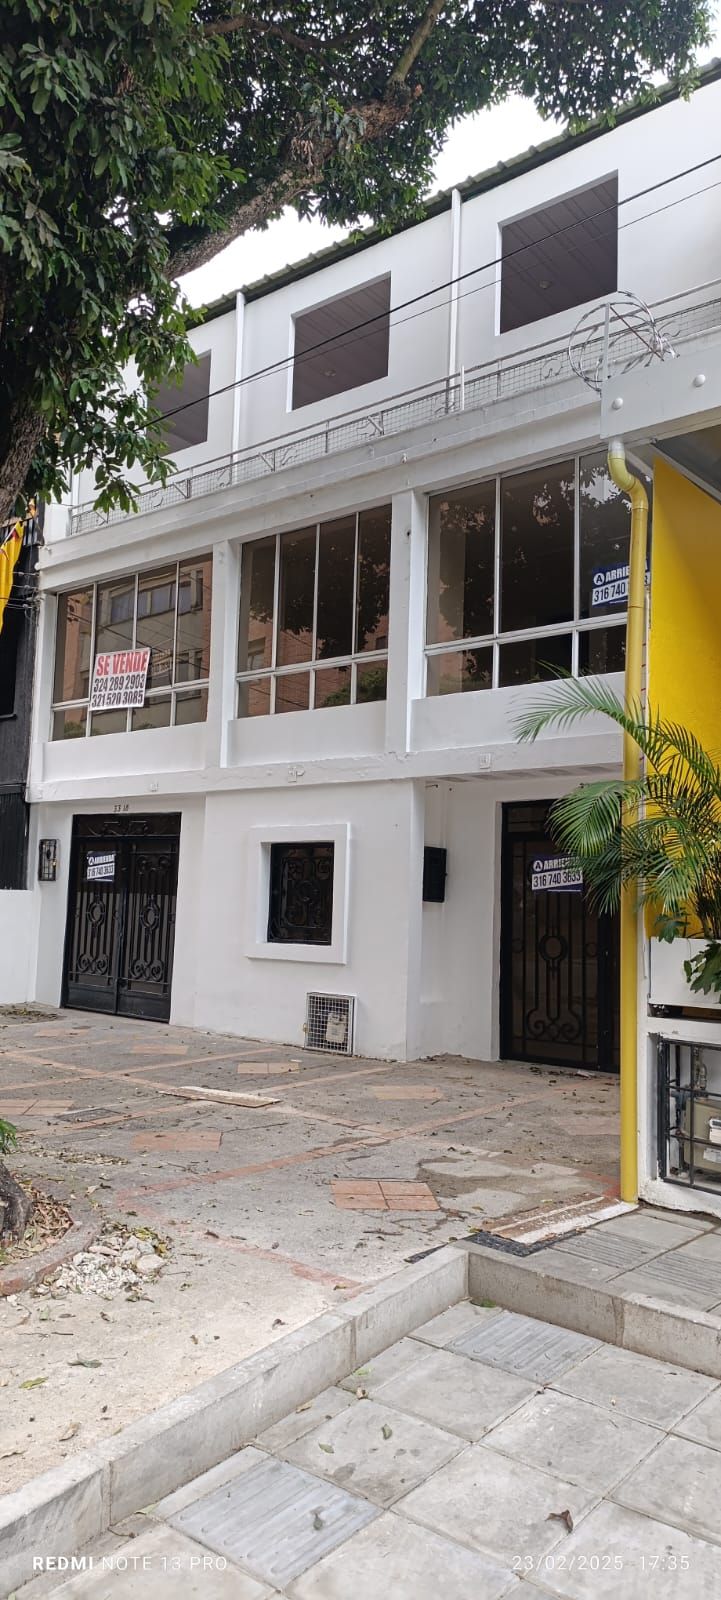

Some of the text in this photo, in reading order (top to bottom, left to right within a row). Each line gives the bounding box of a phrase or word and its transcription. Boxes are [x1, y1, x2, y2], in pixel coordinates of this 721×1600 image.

[594, 582, 626, 602] 316 740
[96, 655, 110, 676] SE
[113, 651, 148, 674] VENDE
[93, 674, 145, 692] 324 289 2903
[92, 690, 143, 708] 321 520 3085
[533, 875, 547, 888] 316
[548, 872, 561, 885] 740
